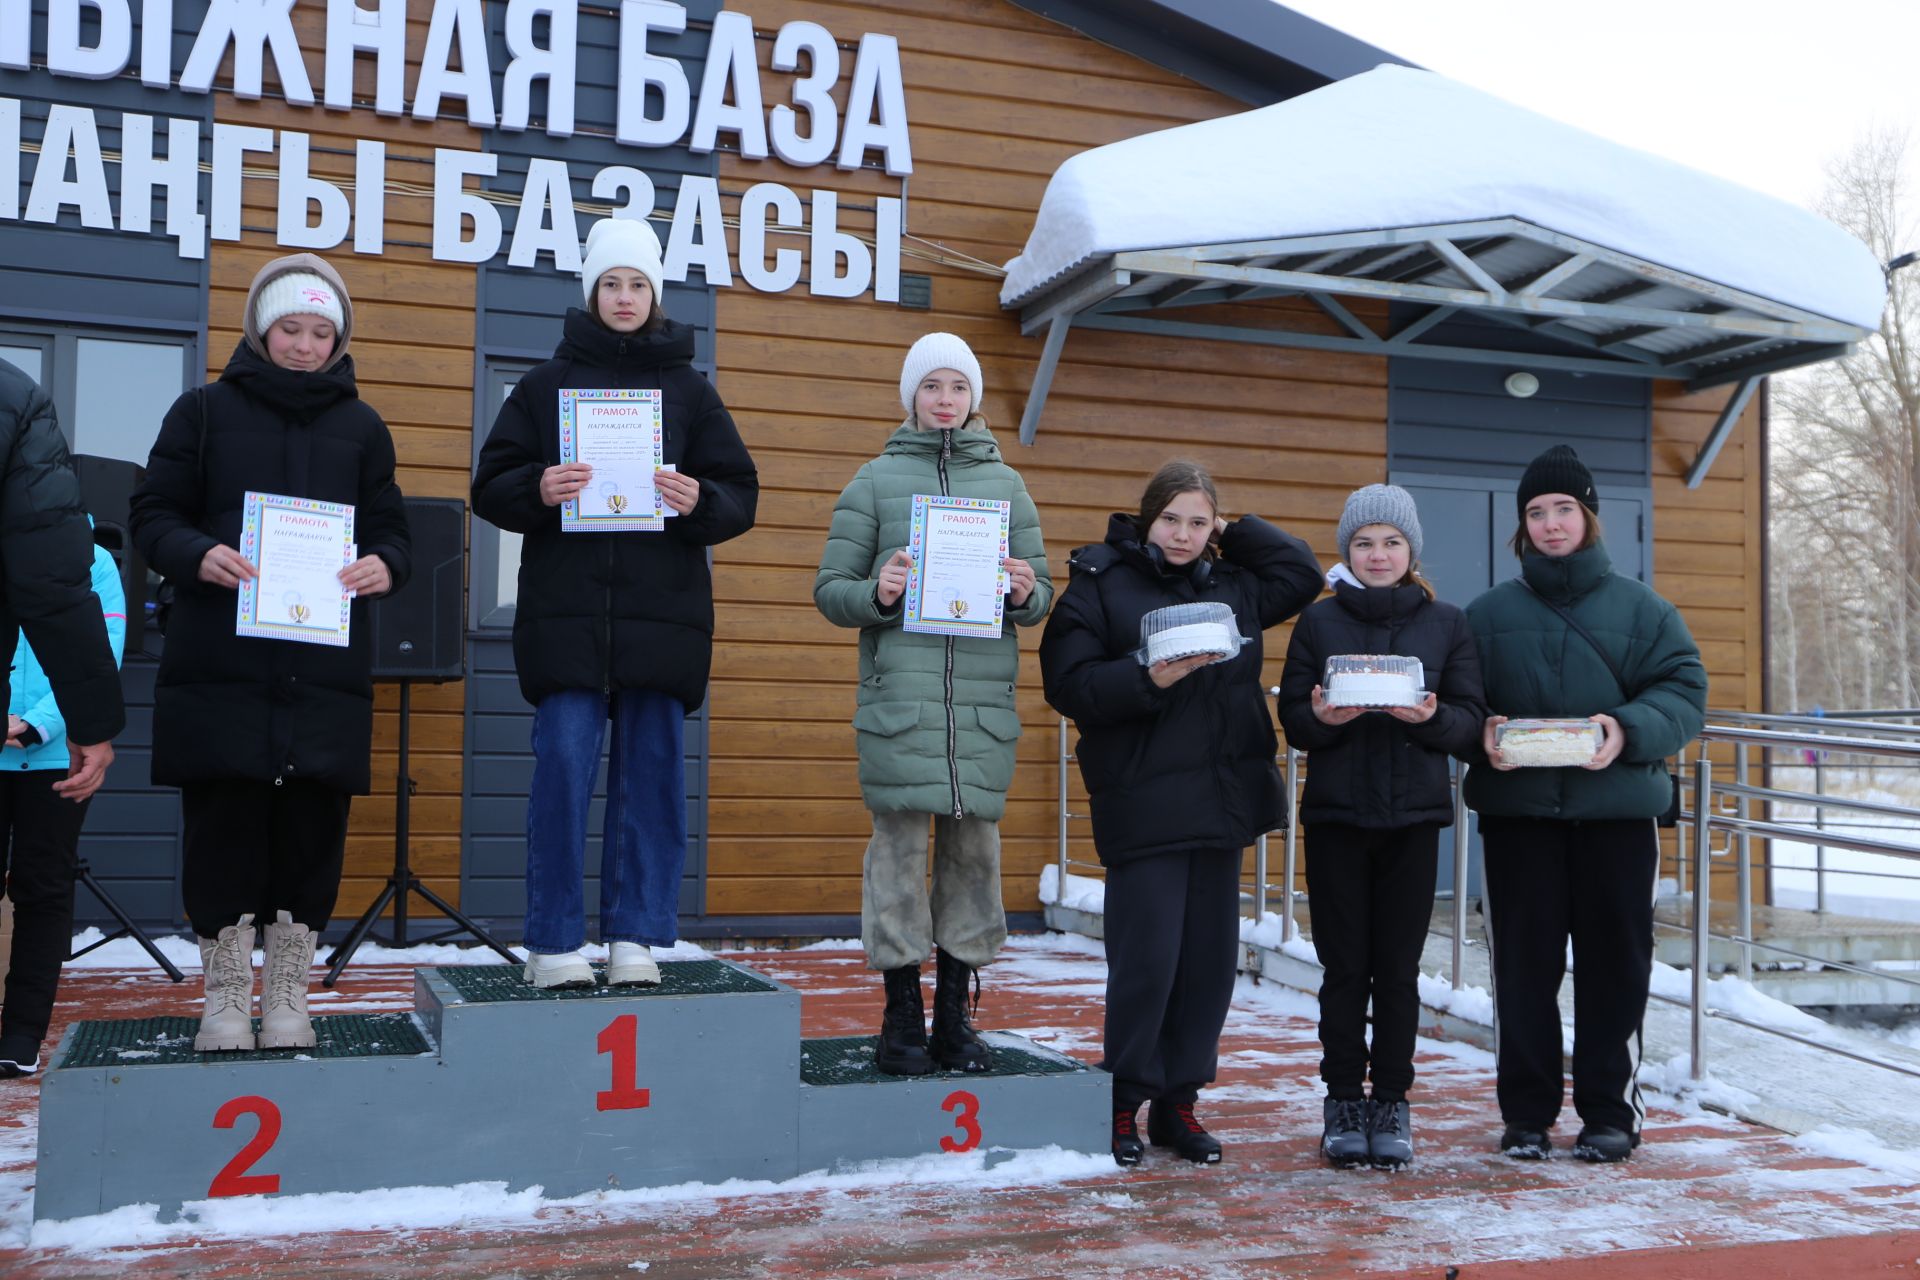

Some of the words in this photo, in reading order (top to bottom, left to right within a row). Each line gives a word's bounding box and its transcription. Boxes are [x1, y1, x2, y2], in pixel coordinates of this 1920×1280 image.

[615, 0, 913, 176] БАЗА
[592, 408, 638, 416] ГРАМОТА
[280, 514, 328, 528] ГРАМОТА
[942, 515, 986, 525] ГРАМОТА
[596, 1014, 650, 1112] 1
[208, 1095, 282, 1198] 2
[939, 1090, 982, 1153] 3
